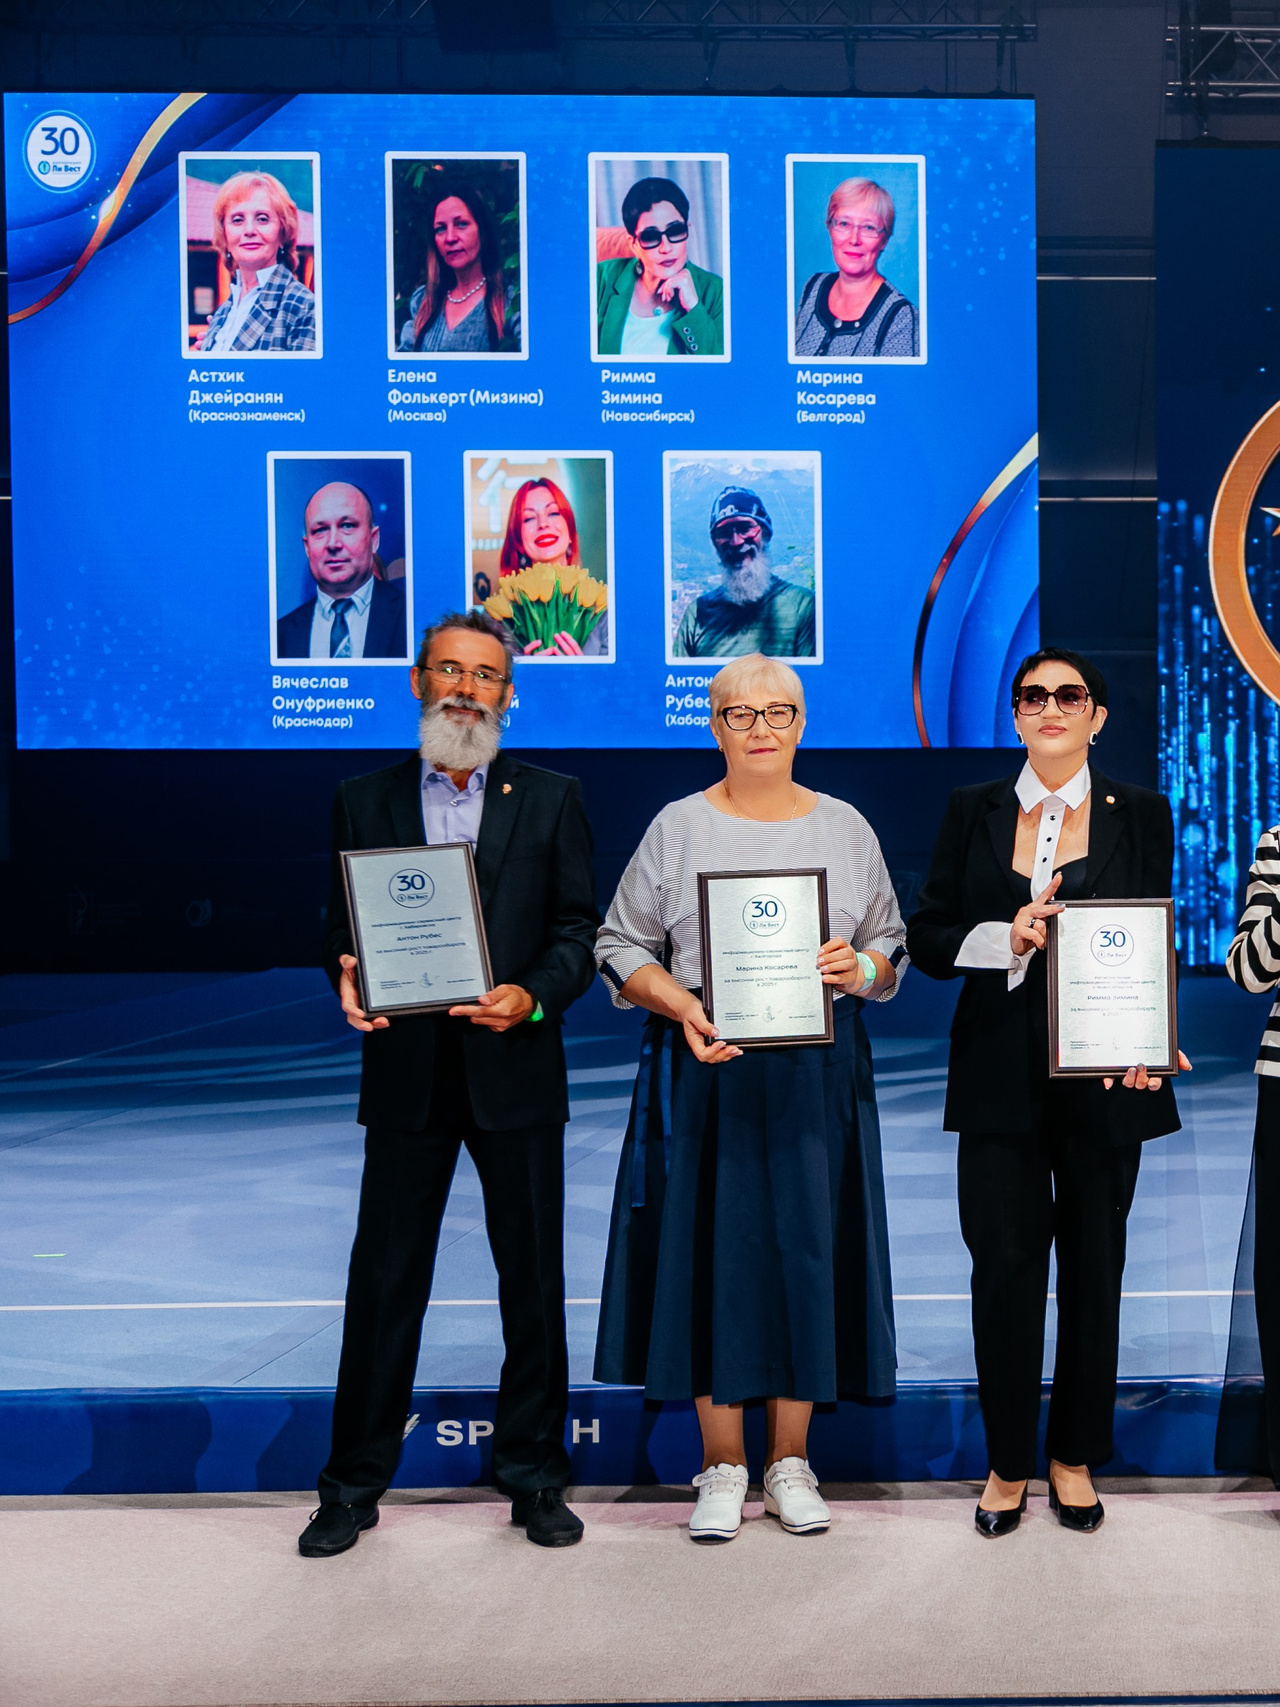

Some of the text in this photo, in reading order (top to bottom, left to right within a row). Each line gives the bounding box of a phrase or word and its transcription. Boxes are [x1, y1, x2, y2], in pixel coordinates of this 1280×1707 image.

[41, 126, 80, 156] 30
[64, 164, 81, 173] Вест
[188, 369, 245, 382] Астхик
[387, 369, 437, 383] Елена
[601, 369, 656, 383] Римма
[796, 370, 863, 387] Марина
[188, 389, 284, 407] Джейранян
[387, 388, 544, 407] Фолькерт (Мизина)
[601, 390, 663, 404] Зимина
[797, 391, 876, 408] Косарева
[188, 408, 306, 423] (Краснознаменск)
[387, 408, 447, 423] (Москва)
[601, 409, 695, 424] (Новосибирск)
[796, 410, 866, 424] (Белгород)
[272, 675, 349, 689] Вячеслав
[665, 674, 713, 688] Антон
[272, 695, 375, 713] Онуфриенко
[272, 714, 353, 729] (Краснодар)
[665, 713, 710, 728] (Хабар
[397, 874, 425, 892] 30
[752, 901, 778, 918] 30
[1100, 931, 1126, 947] 30
[436, 1419, 600, 1446] SPH
